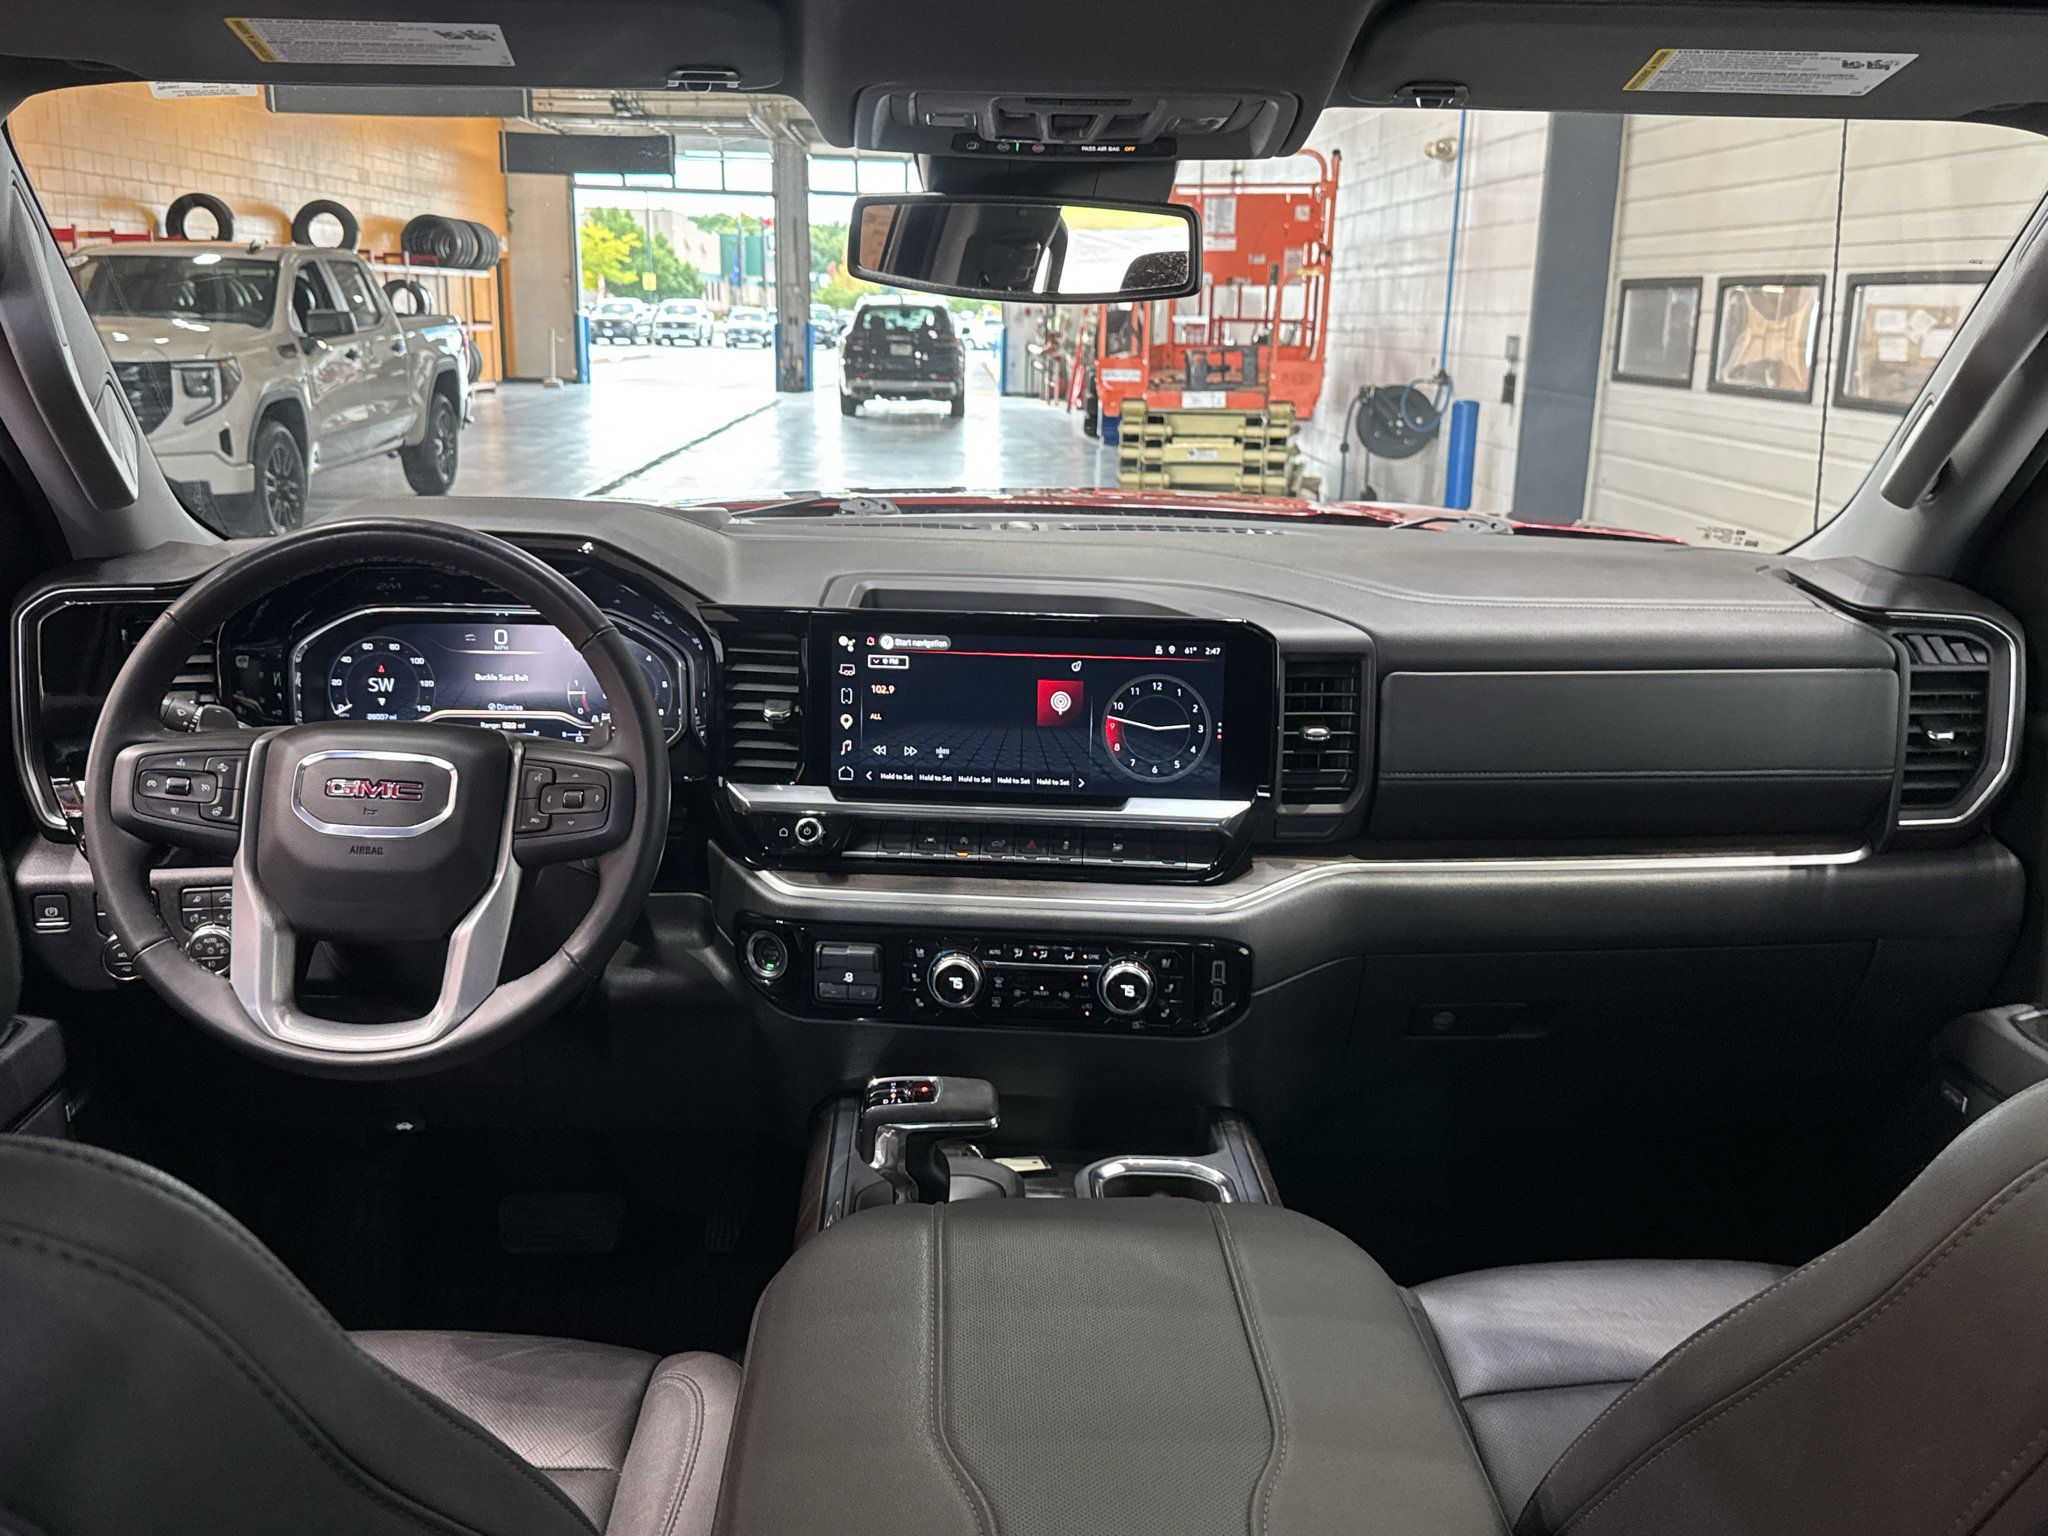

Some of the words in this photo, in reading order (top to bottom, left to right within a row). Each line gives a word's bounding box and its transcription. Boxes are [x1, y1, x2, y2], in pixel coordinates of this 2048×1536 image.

[494, 629, 508, 645] 0
[894, 638, 912, 646] Start
[912, 639, 948, 649] navigation
[1205, 647, 1221, 655] 2:47
[410, 657, 425, 665] 100
[474, 673, 498, 681] Buckle
[499, 673, 514, 681] Seat
[514, 673, 529, 682] Belt
[367, 677, 395, 692] SW
[871, 684, 895, 694] 102.9
[1152, 682, 1163, 691] 12
[1130, 687, 1140, 696] 11
[1176, 688, 1183, 697] 1
[417, 704, 431, 712] 140
[496, 703, 524, 711] Dismiss
[1113, 701, 1124, 711] 10
[1192, 704, 1199, 713] 2
[1197, 724, 1204, 734] 3
[1113, 742, 1121, 752] 8
[1190, 745, 1197, 754] 4
[1130, 758, 1137, 768] 7
[1174, 760, 1181, 770] 5
[1151, 765, 1159, 774] 6
[958, 775, 973, 783] Hold
[981, 776, 992, 784] Set
[997, 776, 1012, 784] Hold
[1020, 777, 1031, 785] Set
[1036, 778, 1051, 786] Hold
[1059, 778, 1070, 786] Set
[326, 779, 423, 800] GMC
[349, 846, 384, 856] AIRBAG
